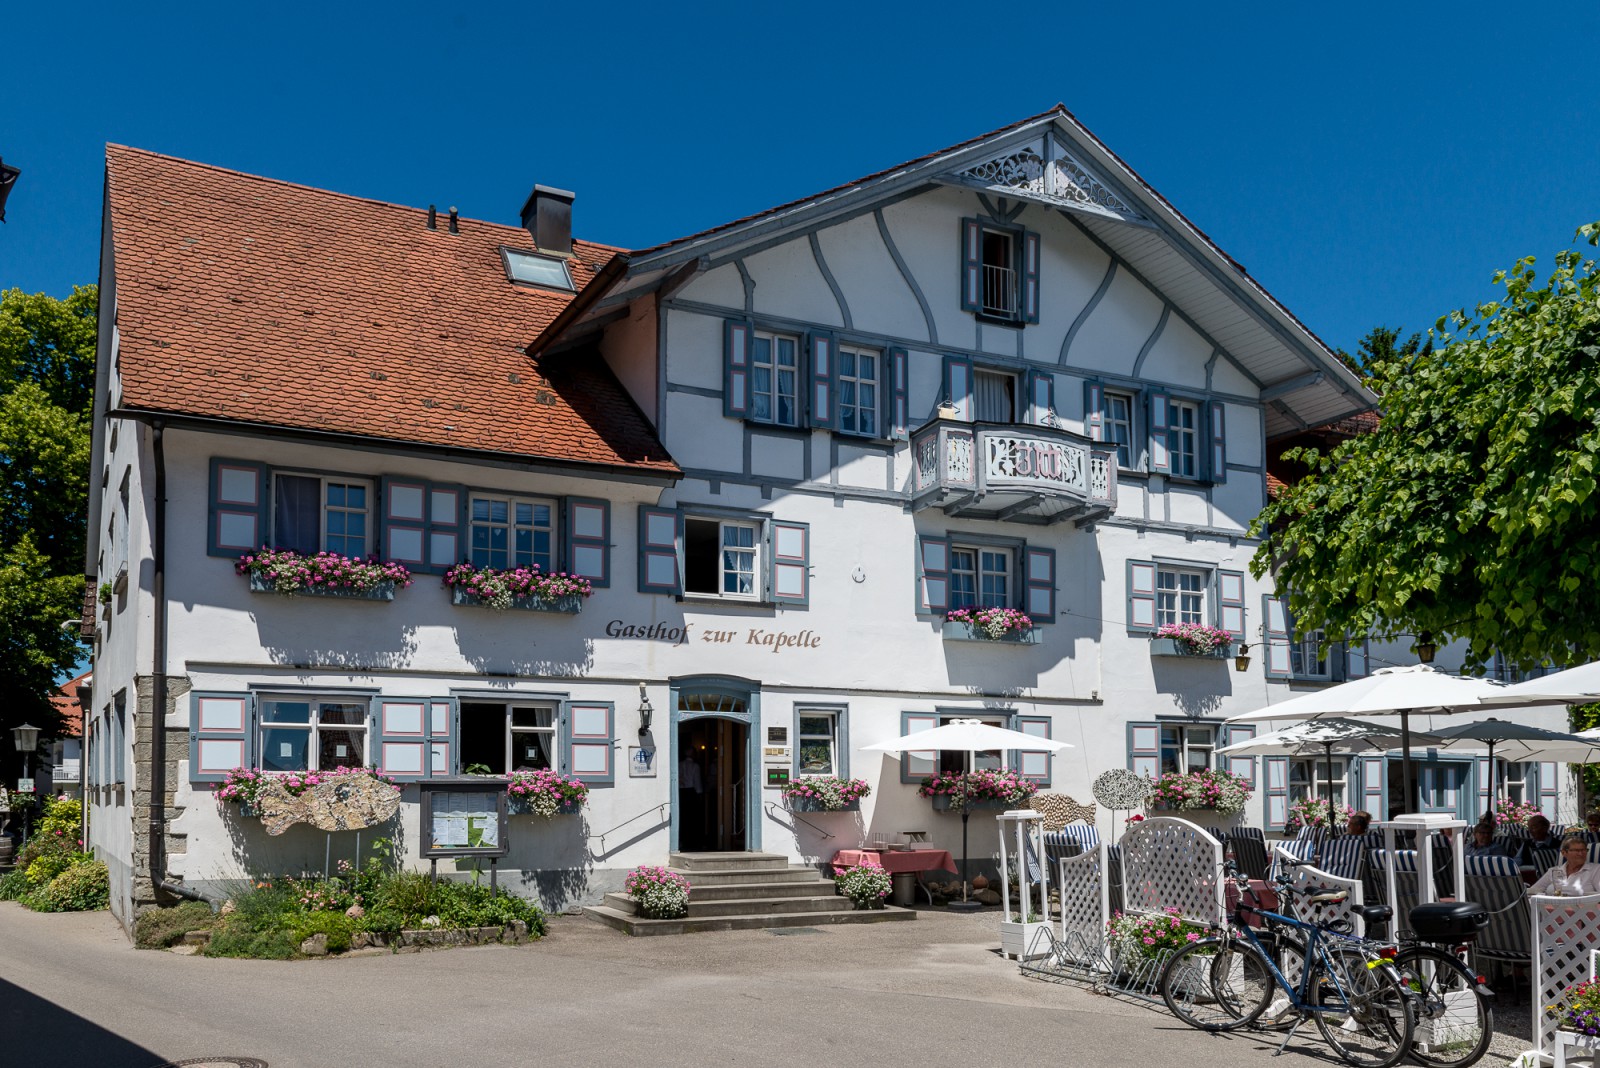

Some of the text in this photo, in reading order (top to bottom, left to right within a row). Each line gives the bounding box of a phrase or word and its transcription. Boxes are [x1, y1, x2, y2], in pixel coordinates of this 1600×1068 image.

[606, 620, 821, 653] Gasthof zur Kapelle
